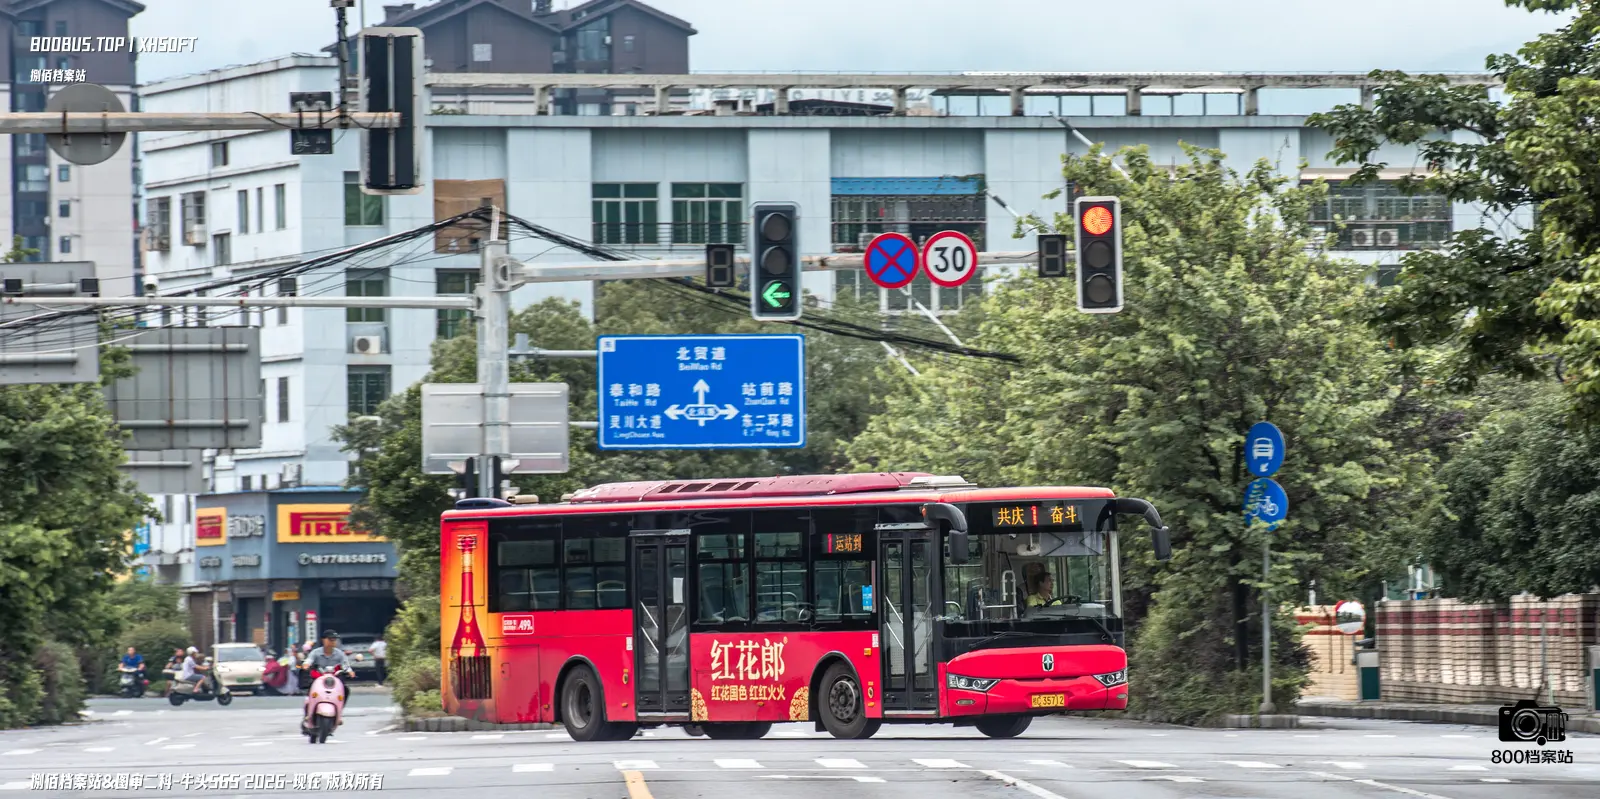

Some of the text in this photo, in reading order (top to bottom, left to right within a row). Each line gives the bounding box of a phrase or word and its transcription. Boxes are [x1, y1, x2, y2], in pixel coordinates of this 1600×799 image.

[934, 246, 966, 273] 30
[711, 362, 723, 371] Rd
[609, 383, 661, 397] 泰和路
[741, 381, 793, 396] 站前路
[609, 415, 662, 429] 灵川大道
[741, 413, 794, 428] 东二环路
[997, 505, 1077, 526] 共庆 1 奋斗
[835, 534, 862, 552] 运站到
[710, 638, 785, 681] 红花郎
[711, 684, 786, 701] 红花国色 红红火火
